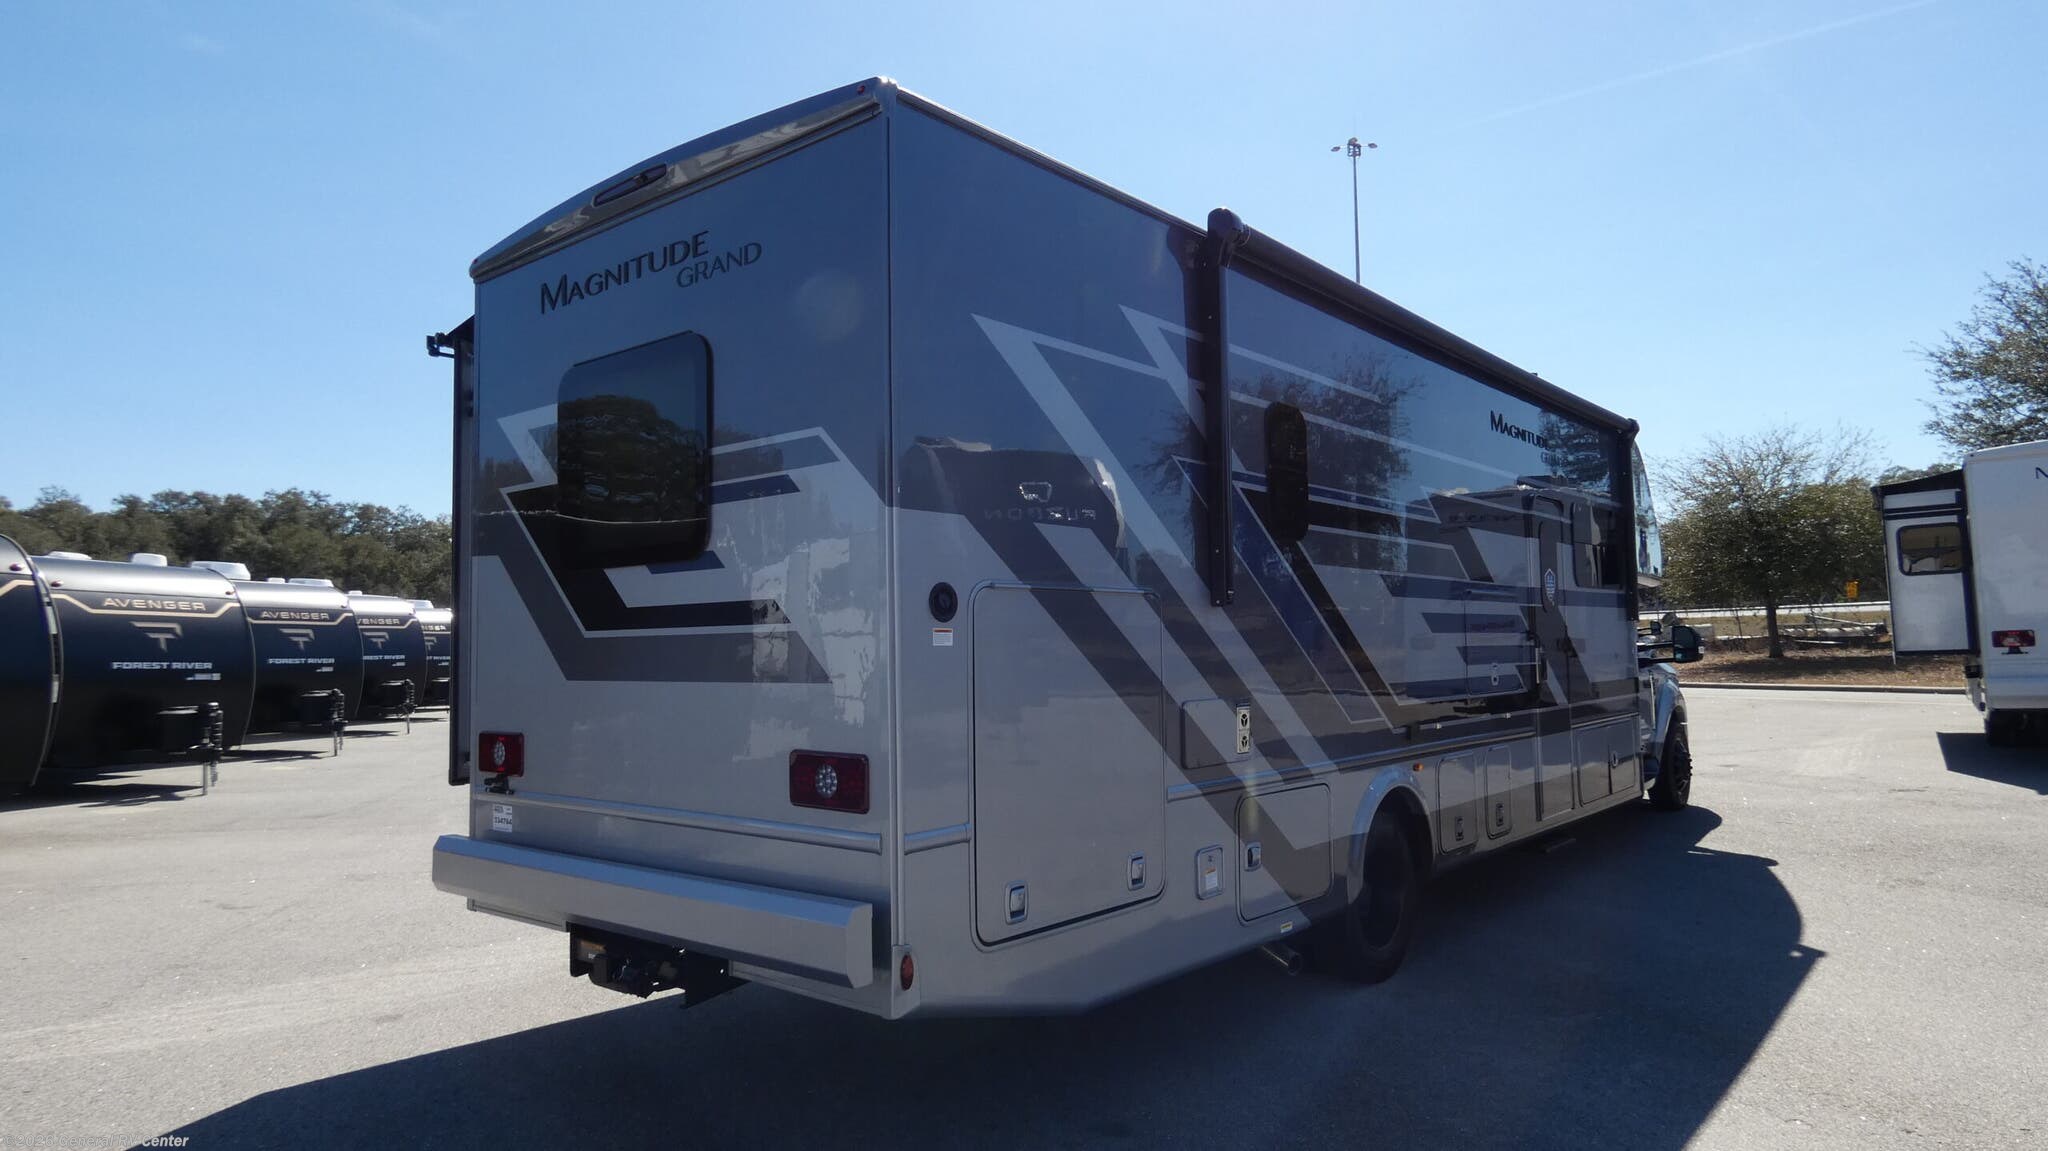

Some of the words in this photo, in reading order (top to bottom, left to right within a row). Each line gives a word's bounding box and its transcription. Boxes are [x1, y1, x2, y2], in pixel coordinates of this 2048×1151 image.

[541, 230, 709, 314] MAGNITUDE
[676, 242, 762, 288] GRAND
[103, 597, 206, 611] AVENGER
[261, 611, 329, 620] AVENGER
[112, 661, 170, 670] FOREST
[171, 662, 213, 670] RIVER
